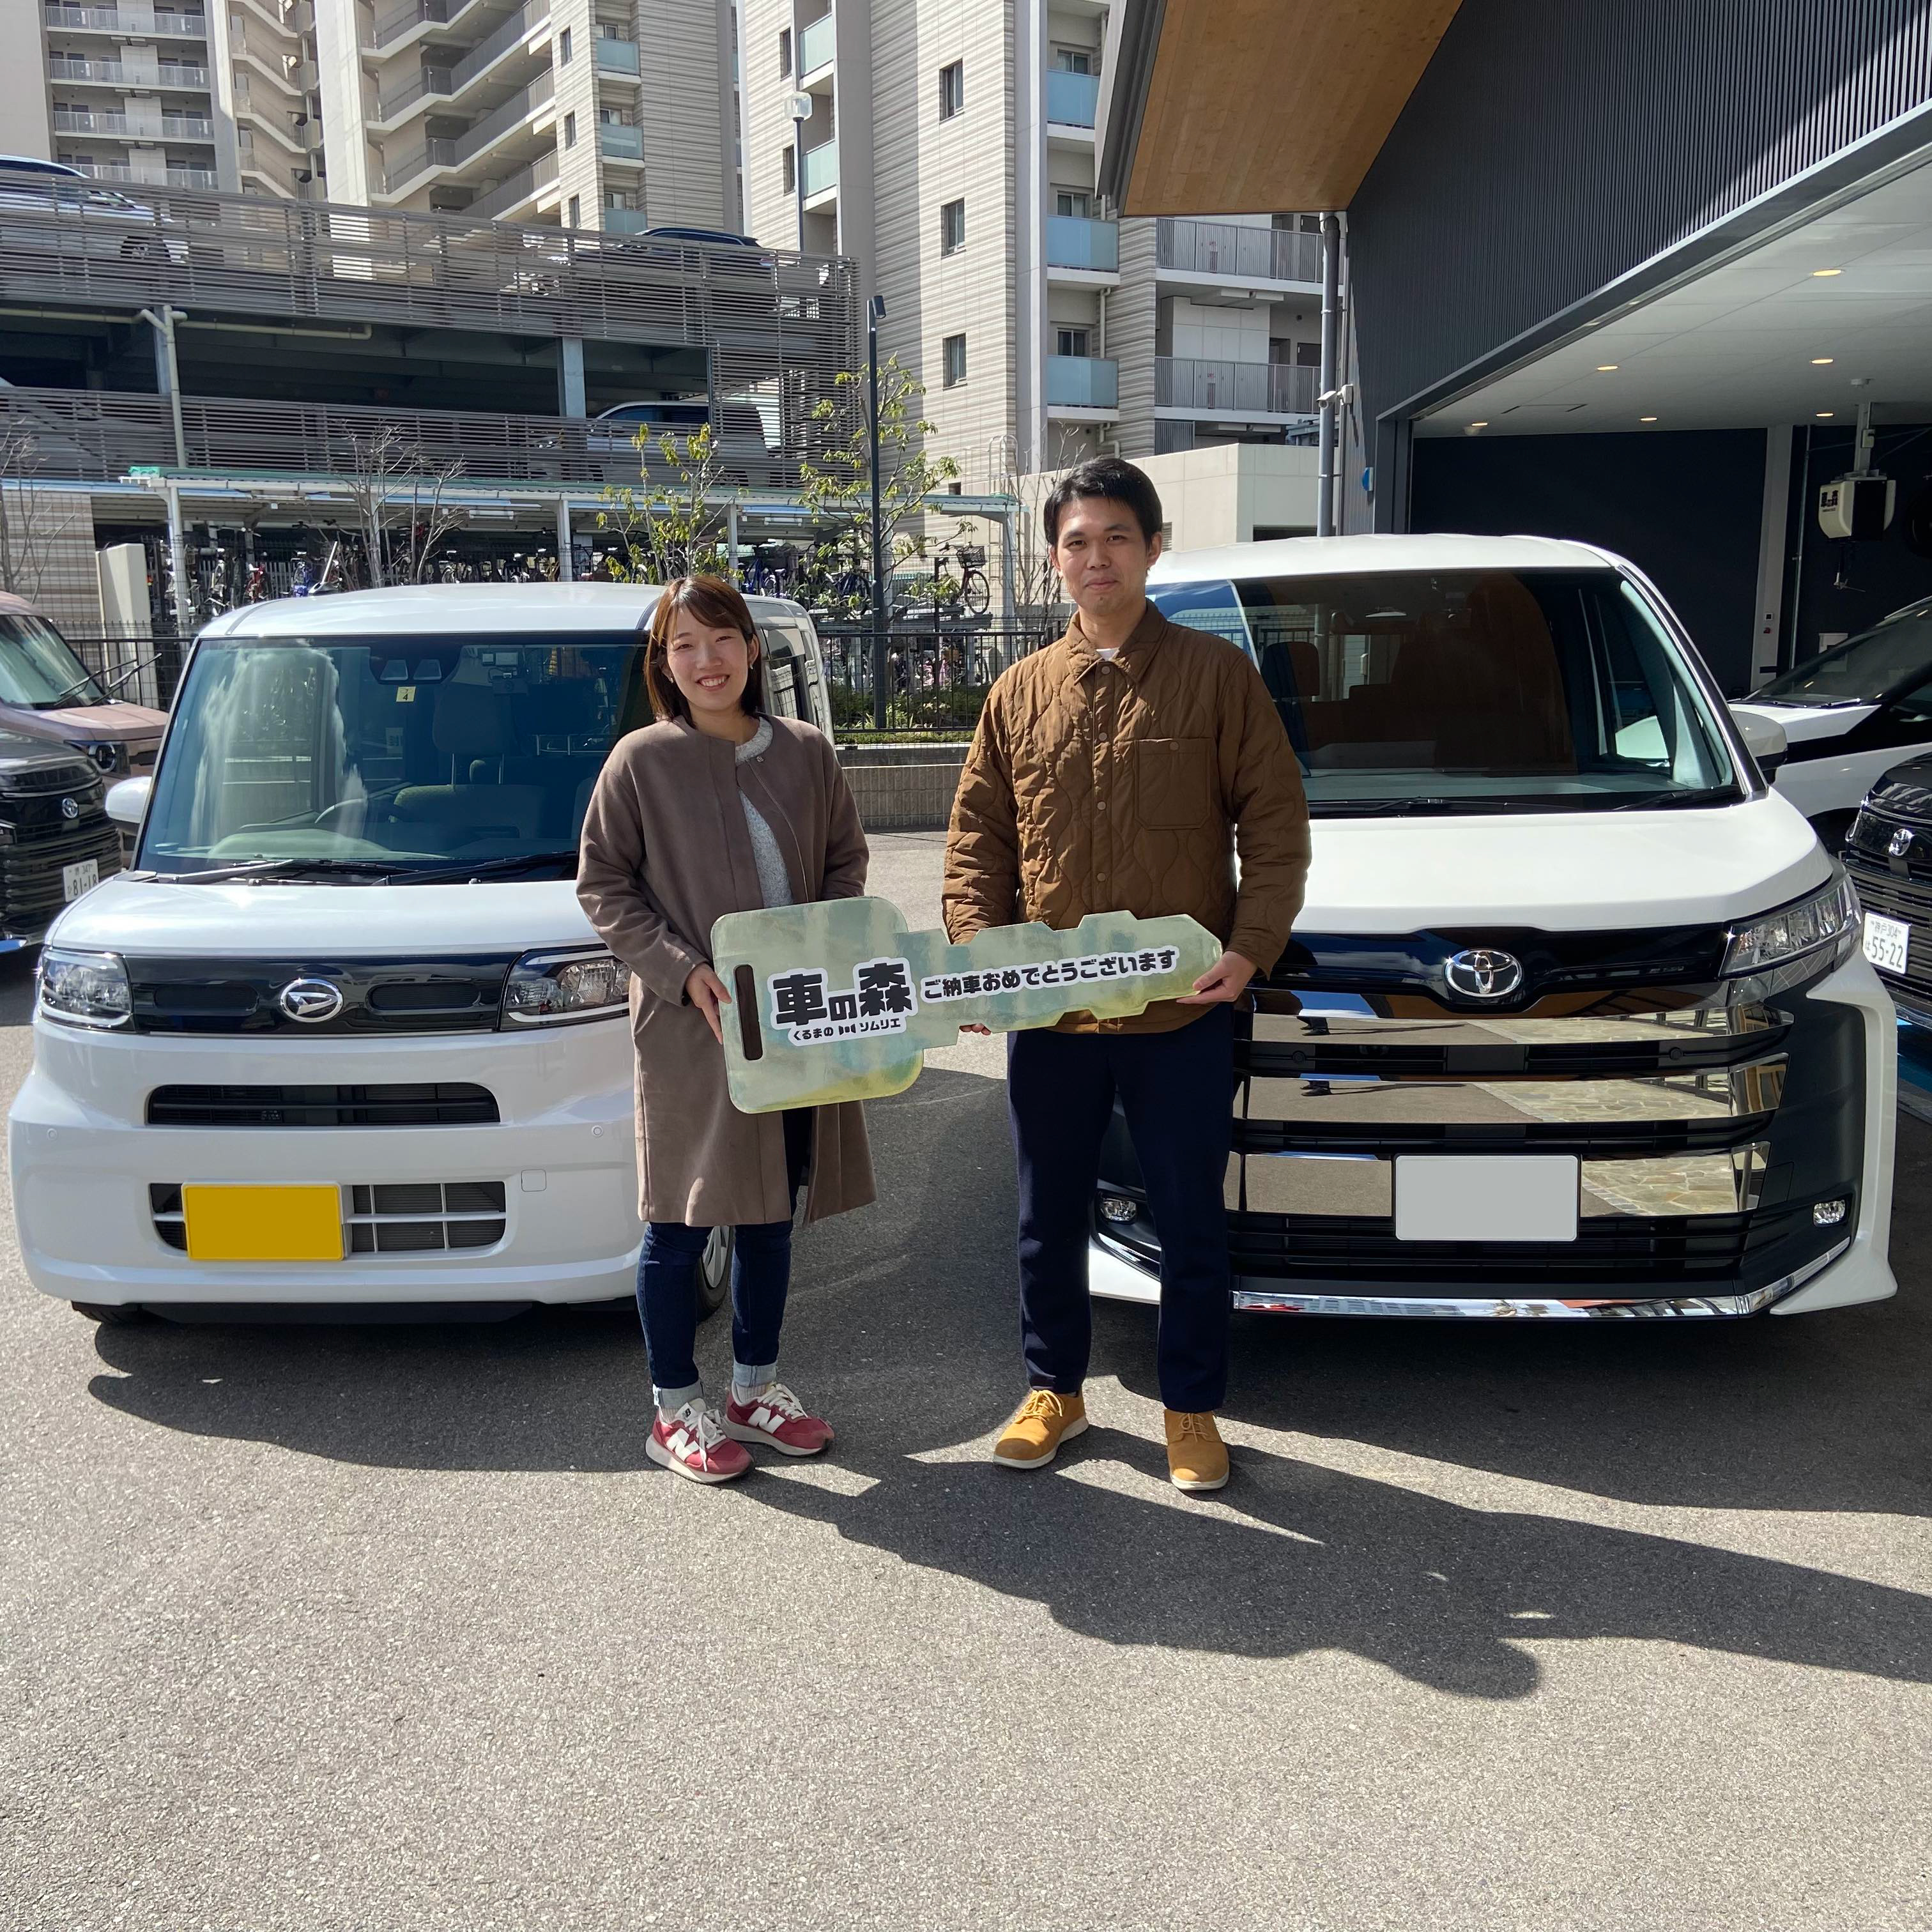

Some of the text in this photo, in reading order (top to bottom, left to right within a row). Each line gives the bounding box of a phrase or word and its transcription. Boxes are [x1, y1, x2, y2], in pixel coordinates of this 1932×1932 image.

[773, 962, 913, 1025] 車の森
[924, 949, 1176, 999] ご納車おめでとうございます
[793, 1018, 901, 1041] くるまの ソムリエ
